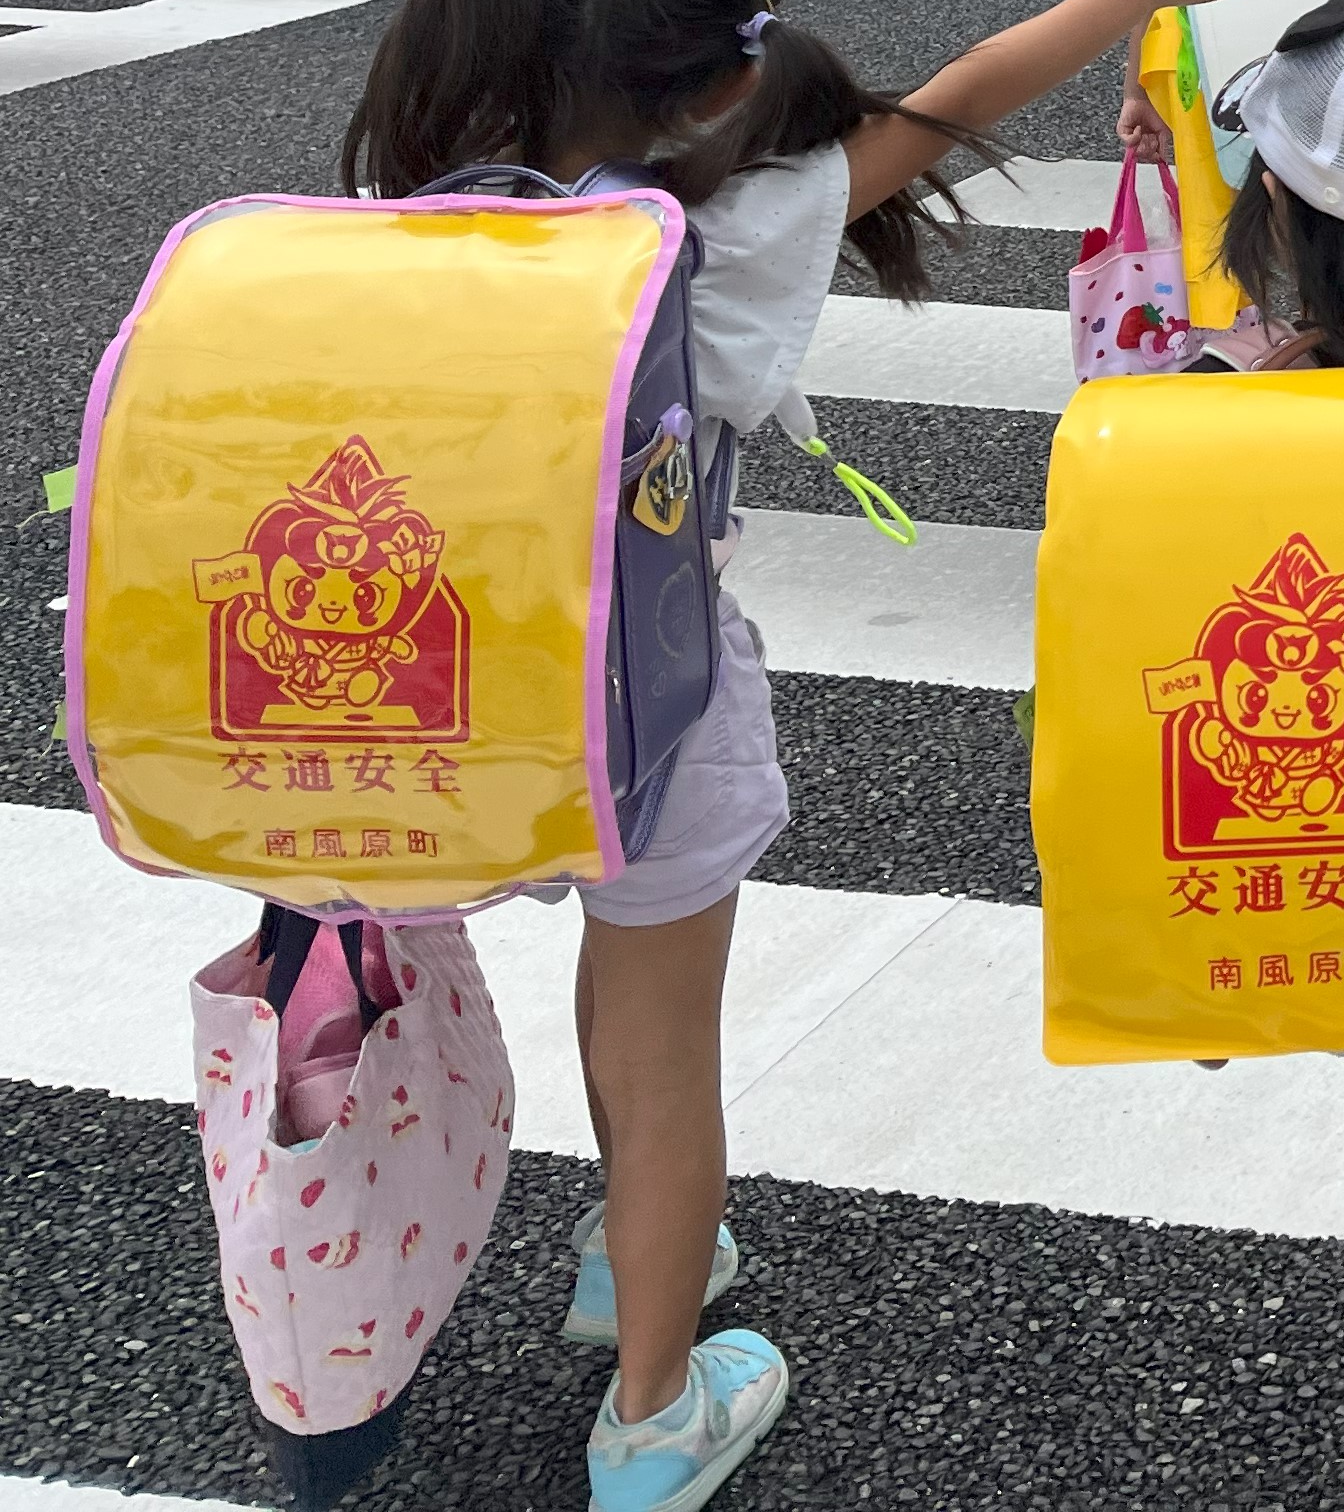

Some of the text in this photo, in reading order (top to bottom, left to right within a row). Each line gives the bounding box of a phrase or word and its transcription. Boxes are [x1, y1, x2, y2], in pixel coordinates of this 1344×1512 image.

[217, 747, 463, 794] 交通安全
[263, 828, 440, 859] 南風原町
